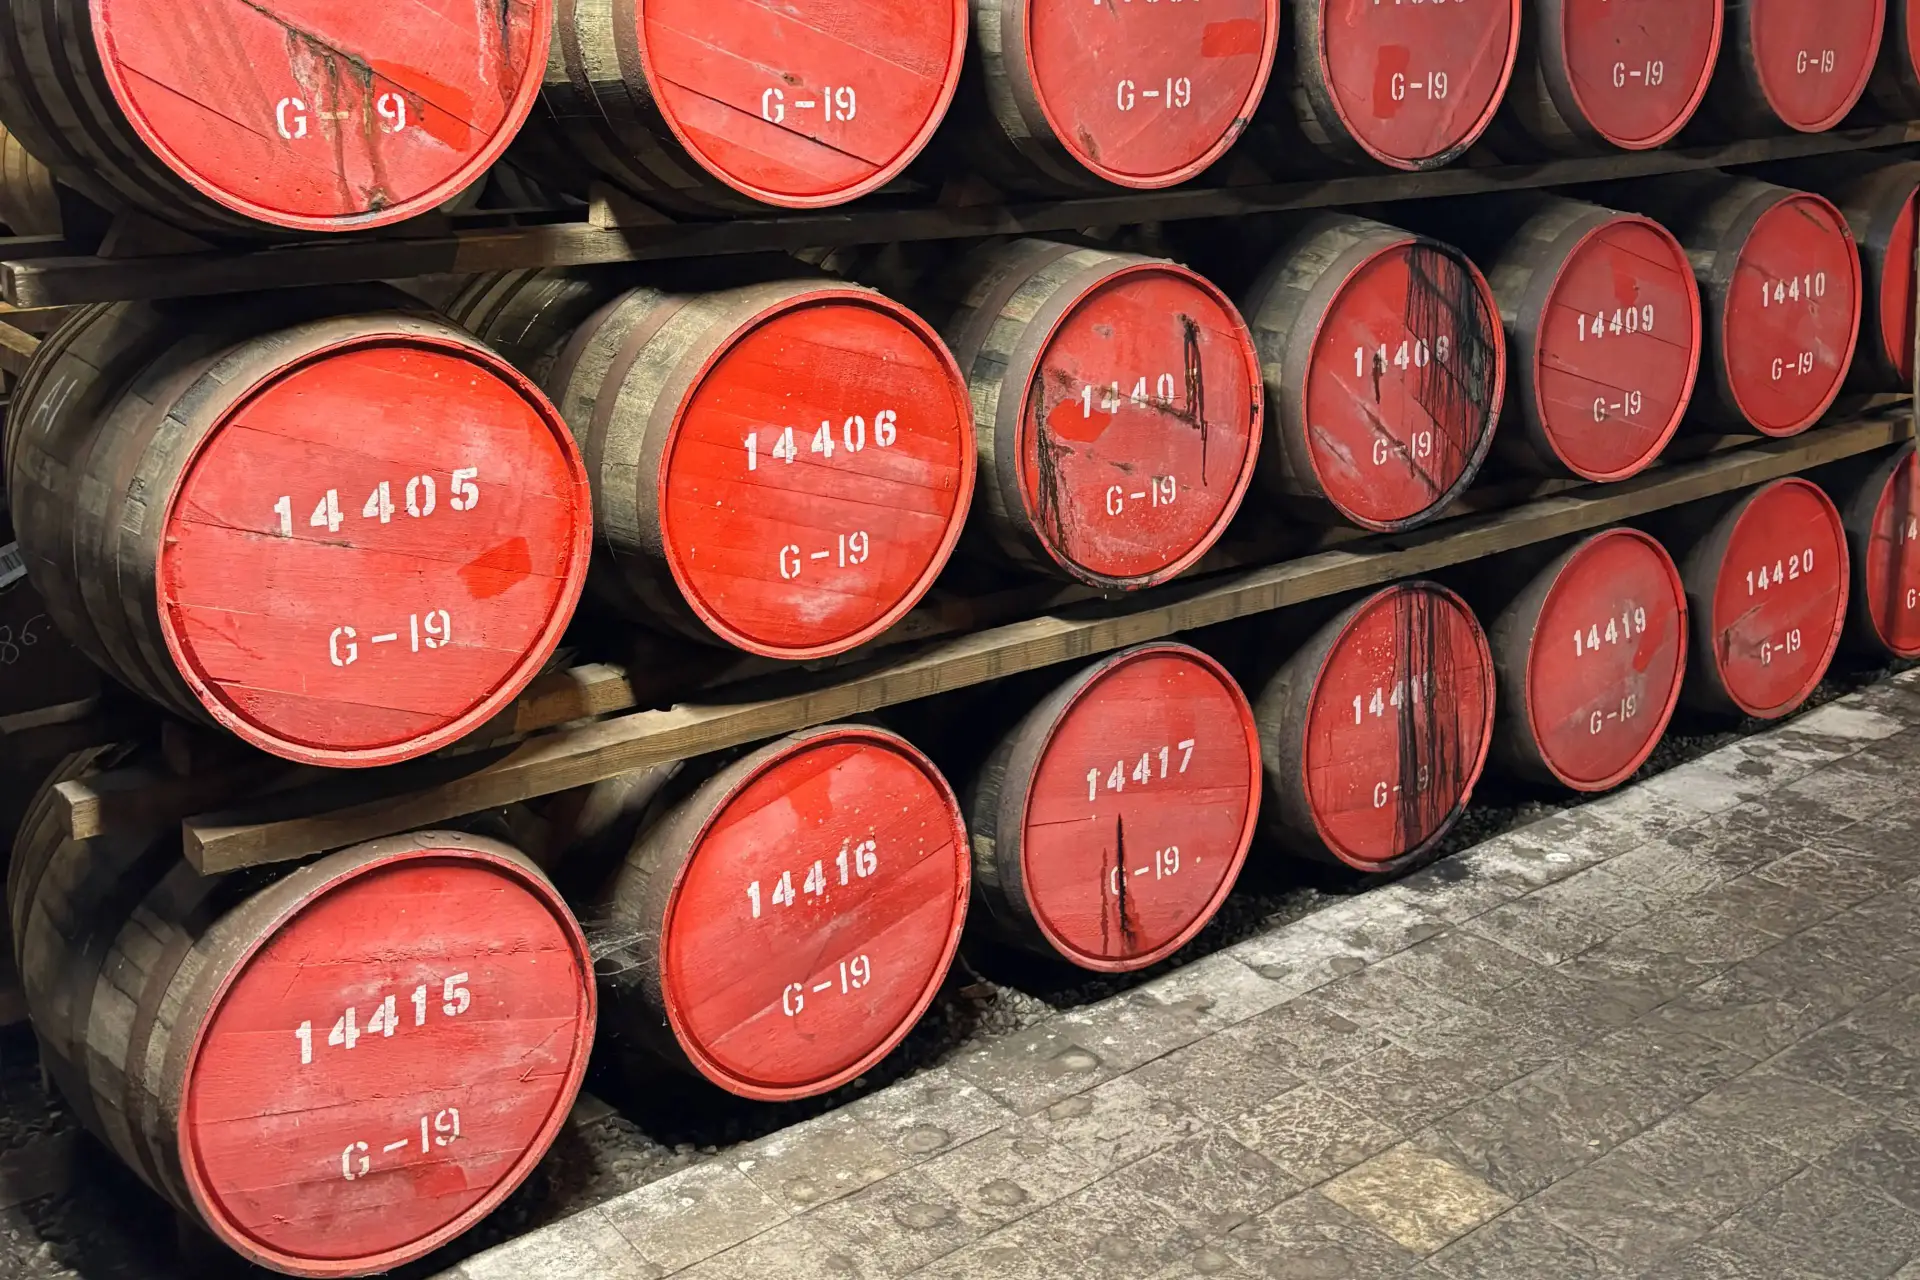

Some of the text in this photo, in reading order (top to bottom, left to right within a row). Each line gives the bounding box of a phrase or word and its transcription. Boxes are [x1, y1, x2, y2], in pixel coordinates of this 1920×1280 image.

[1613, 60, 1664, 88] G-19
[1796, 49, 1834, 74] G-19
[762, 86, 856, 124] G-19
[1117, 77, 1191, 111] G-19
[1391, 71, 1448, 101] G-19
[1762, 272, 1825, 307] 14410
[1577, 304, 1654, 342] 14409
[1771, 351, 1814, 381] G-19
[1081, 367, 1198, 418] 1440
[1593, 391, 1641, 422] G-19
[744, 409, 897, 471] 14406
[273, 466, 479, 538] 14405
[1106, 475, 1176, 516] G-19
[779, 530, 869, 579] G-19
[1746, 548, 1814, 596] 14420
[328, 609, 452, 667] G-19
[1573, 607, 1646, 657] 14419
[1760, 628, 1801, 664] G-19
[1590, 694, 1637, 735] G-19
[1086, 738, 1195, 802] 14417
[746, 841, 878, 911] 14416
[782, 954, 871, 1017] G-19
[294, 971, 471, 1065] 14415
[341, 1107, 460, 1180] G-19
